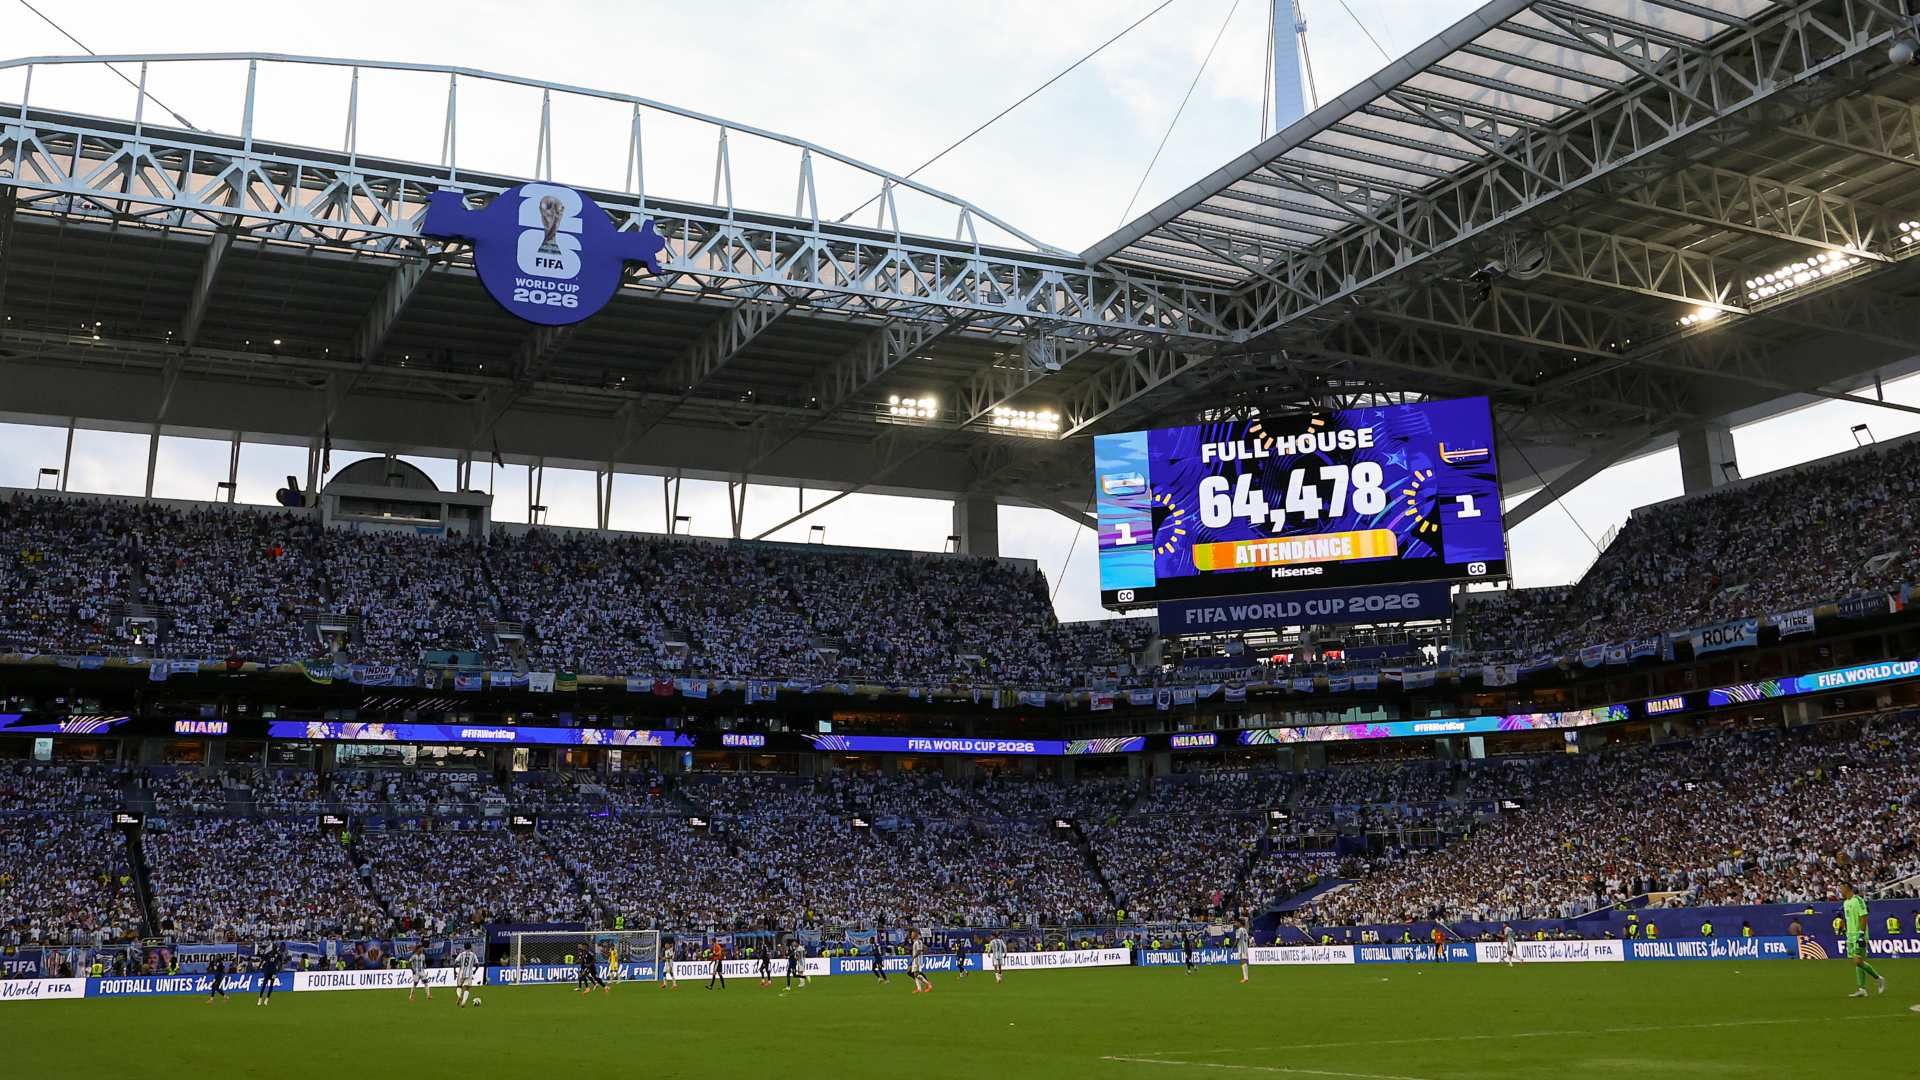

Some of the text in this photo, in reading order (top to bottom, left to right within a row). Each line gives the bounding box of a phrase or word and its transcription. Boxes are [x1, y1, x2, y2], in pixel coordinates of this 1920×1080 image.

[535, 257, 564, 270] FIFA
[515, 277, 580, 293] WORLD CUP
[513, 287, 579, 308] 2026
[1201, 427, 1374, 464] FULL HOUSE
[1198, 461, 1387, 533] 64,478
[1455, 494, 1481, 518] 1
[1114, 522, 1137, 546] 1
[1235, 536, 1353, 565] ATTENDANCE
[1271, 566, 1323, 579] Hisense
[1185, 592, 1421, 625] FIFA WORLD CUP 2026
[1702, 625, 1745, 648] ROCK
[1818, 661, 1918, 687] FIFA WORLD CUP
[1647, 697, 1683, 713] MIAMI
[175, 720, 228, 734] MIAMI
[722, 734, 765, 746] MIAMI
[908, 739, 1035, 752] FIFA WORLD CUP 2026
[1173, 735, 1214, 747] MIAMI
[1361, 930, 1380, 942] FFA
[1360, 946, 1391, 961] FOOTBALL
[1452, 947, 1468, 957] FIFA
[1521, 944, 1547, 959] UNITES
[1594, 945, 1613, 956] FIFA
[1633, 938, 1787, 958] FOOTBALL UNITES the World FIFA
[1868, 939, 1920, 954] WORLD
[463, 957, 470, 967] 8
[1030, 953, 1057, 966] UNITES
[1073, 951, 1100, 965] World
[1104, 953, 1121, 961] FIFA
[1146, 951, 1180, 964] FOOTBALL
[1254, 950, 1280, 962] FOOTBALL
[1281, 949, 1300, 961] UNITES
[1333, 950, 1347, 959] FIFA
[3, 960, 38, 973] FIFA
[547, 966, 579, 981] UNITES
[633, 966, 653, 977] FIFA
[806, 962, 819, 970] IFA
[99, 978, 153, 994] FOOTBALL
[156, 976, 193, 993] UNITES
[307, 974, 357, 988] FOOTBALL
[359, 972, 393, 986] UNITES
[2, 980, 72, 998] World FIFA
